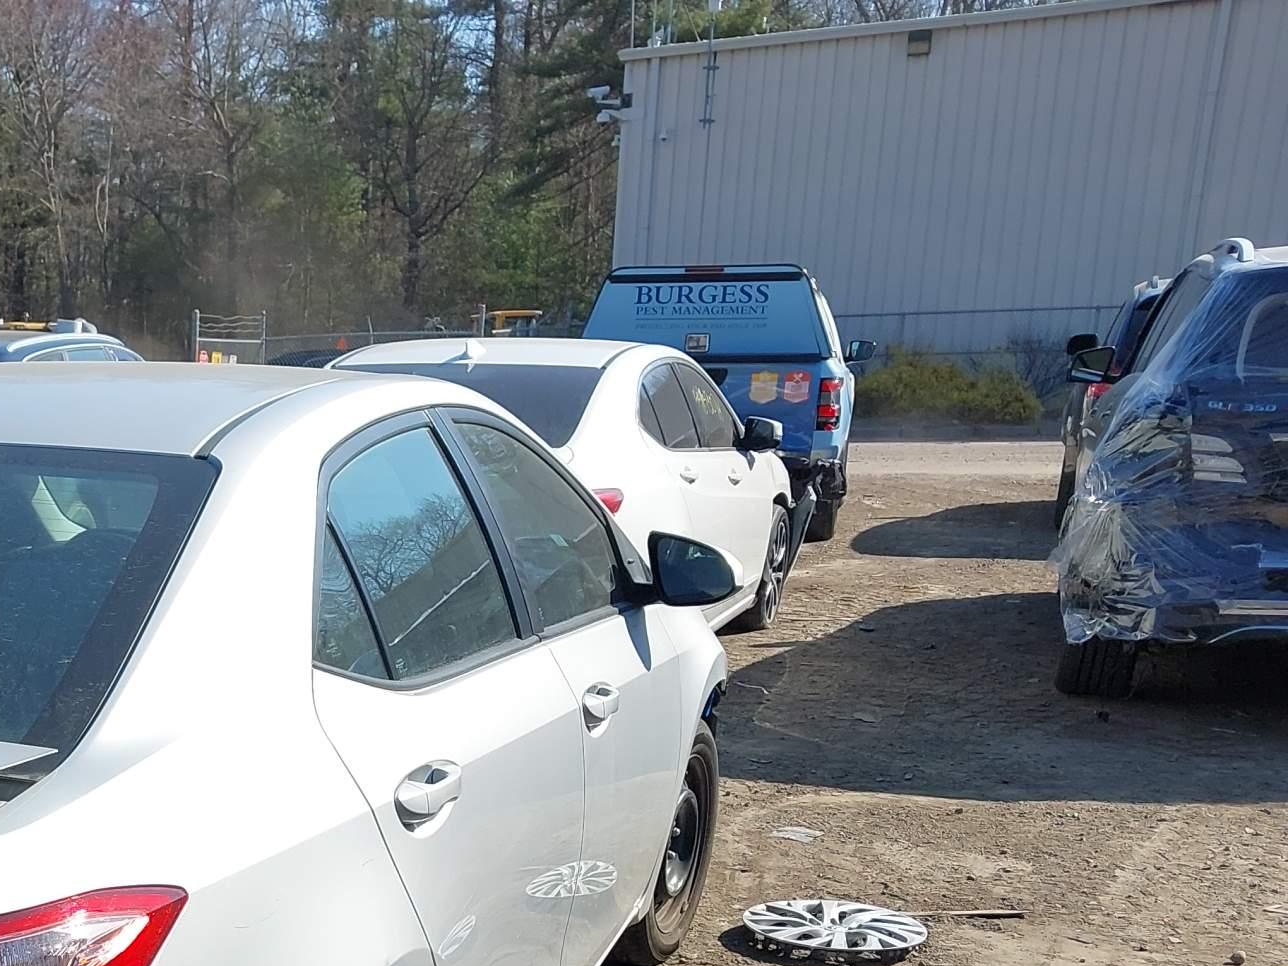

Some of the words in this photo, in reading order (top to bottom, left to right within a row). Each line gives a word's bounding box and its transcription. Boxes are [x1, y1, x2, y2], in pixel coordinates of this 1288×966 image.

[634, 284, 770, 305] BURGESS
[636, 305, 666, 316] PEST
[671, 305, 768, 316] MANAGEMENT
